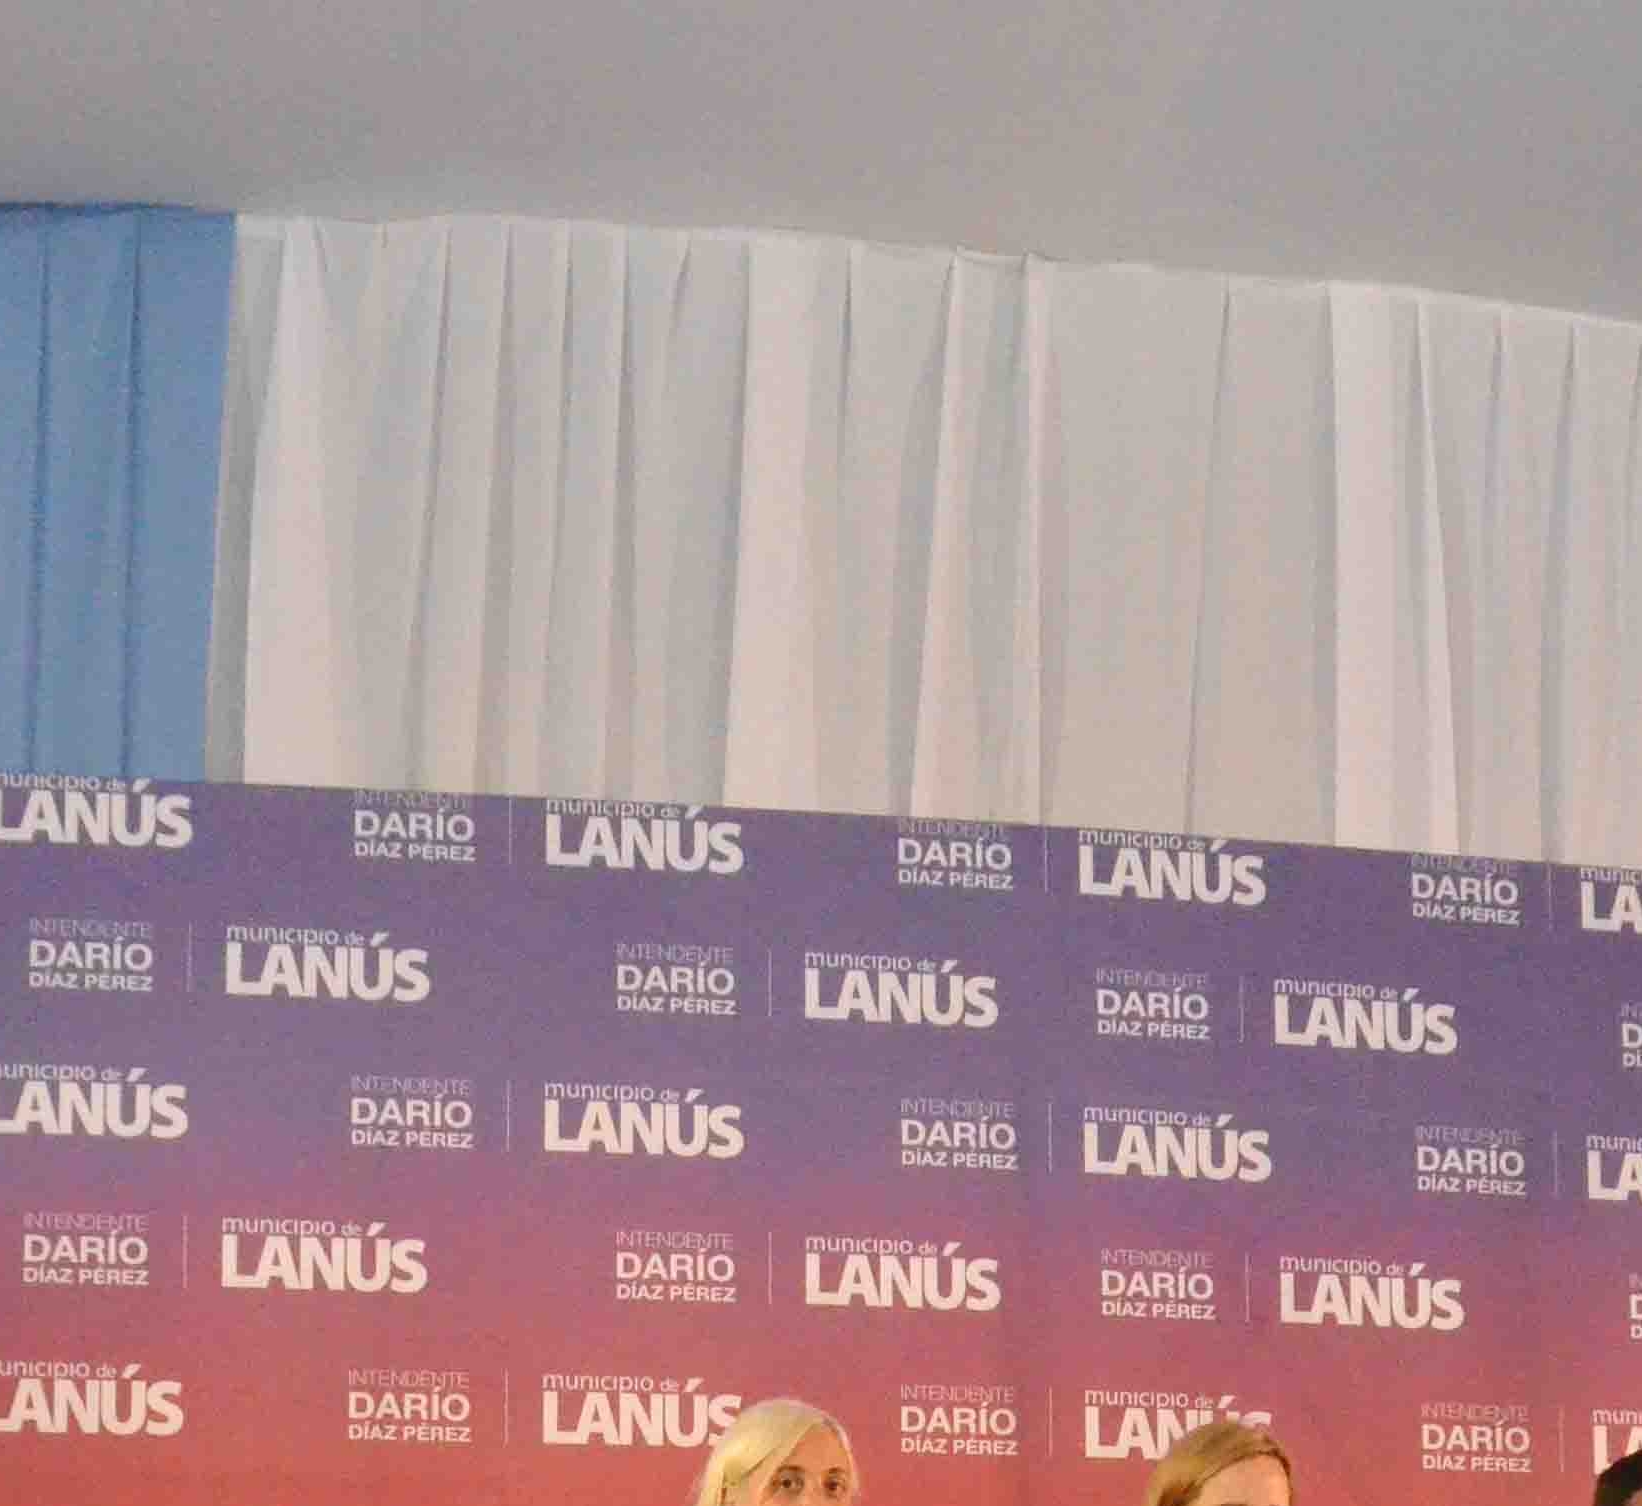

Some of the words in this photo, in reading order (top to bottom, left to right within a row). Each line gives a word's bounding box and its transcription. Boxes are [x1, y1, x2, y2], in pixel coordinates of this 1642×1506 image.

[354, 809, 475, 842] DARÍO
[546, 810, 745, 873] LANÚS
[897, 838, 1012, 870] DARÍO
[1079, 843, 1267, 905] LANÚS
[1411, 875, 1518, 906] DARÍO
[226, 925, 339, 945] municipio
[29, 937, 153, 971] DARÍO
[226, 932, 430, 1002] LANÚS
[804, 951, 911, 971] municipio
[30, 970, 79, 988] DÍAZ
[84, 971, 153, 991] PÉREZ
[616, 961, 735, 995] DARÍO
[805, 959, 999, 1027] LANÚS
[617, 993, 665, 1011] DÍAZ
[670, 995, 736, 1015] PÉREZ
[1096, 987, 1209, 1020] DARÍO
[1097, 1018, 1142, 1035] DÍAZ
[1147, 1020, 1210, 1040] PÉREZ
[1274, 988, 1458, 1054] LANÚS
[544, 1082, 654, 1102] municipio
[351, 1094, 472, 1128] DARÍO
[544, 1088, 744, 1158] LANÚS
[351, 1127, 400, 1145] DÍAZ
[405, 1129, 473, 1149] PÉREZ
[900, 1116, 1016, 1150] DARÍO
[1084, 1114, 1272, 1181] LANÚS
[902, 1148, 948, 1166] DÍAZ
[952, 1150, 1017, 1170] PÉREZ
[1416, 1144, 1524, 1176] DARÍO
[222, 1217, 335, 1236] municipio
[23, 1230, 148, 1265] DARÍO
[222, 1222, 428, 1293] LANÚS
[805, 1236, 913, 1255] municipio
[24, 1265, 73, 1283] DÍAZ
[79, 1266, 148, 1286] PÉREZ
[616, 1248, 735, 1282] DARÍO
[805, 1242, 1001, 1311] LANÚS
[1279, 1256, 1381, 1275] municipio
[616, 1281, 664, 1299] DÍAZ
[669, 1283, 736, 1302] PÉREZ
[1101, 1267, 1214, 1300] DARÍO
[1280, 1263, 1464, 1330] LANÚS
[1102, 1298, 1147, 1316] DÍAZ
[1152, 1300, 1215, 1320] PÉREZ
[542, 1374, 654, 1392] municipio
[348, 1387, 470, 1422] DARÍO
[900, 1401, 1017, 1436] DARÍO
[349, 1421, 397, 1440] DÍAZ
[403, 1422, 471, 1442] PÉREZ
[901, 1435, 948, 1453] DÍAZ
[953, 1436, 1018, 1456] PÉREZ
[1421, 1420, 1530, 1453] DARÍO
[1423, 1452, 1466, 1470] DÍAZ
[1471, 1454, 1531, 1473] PÉREZ
